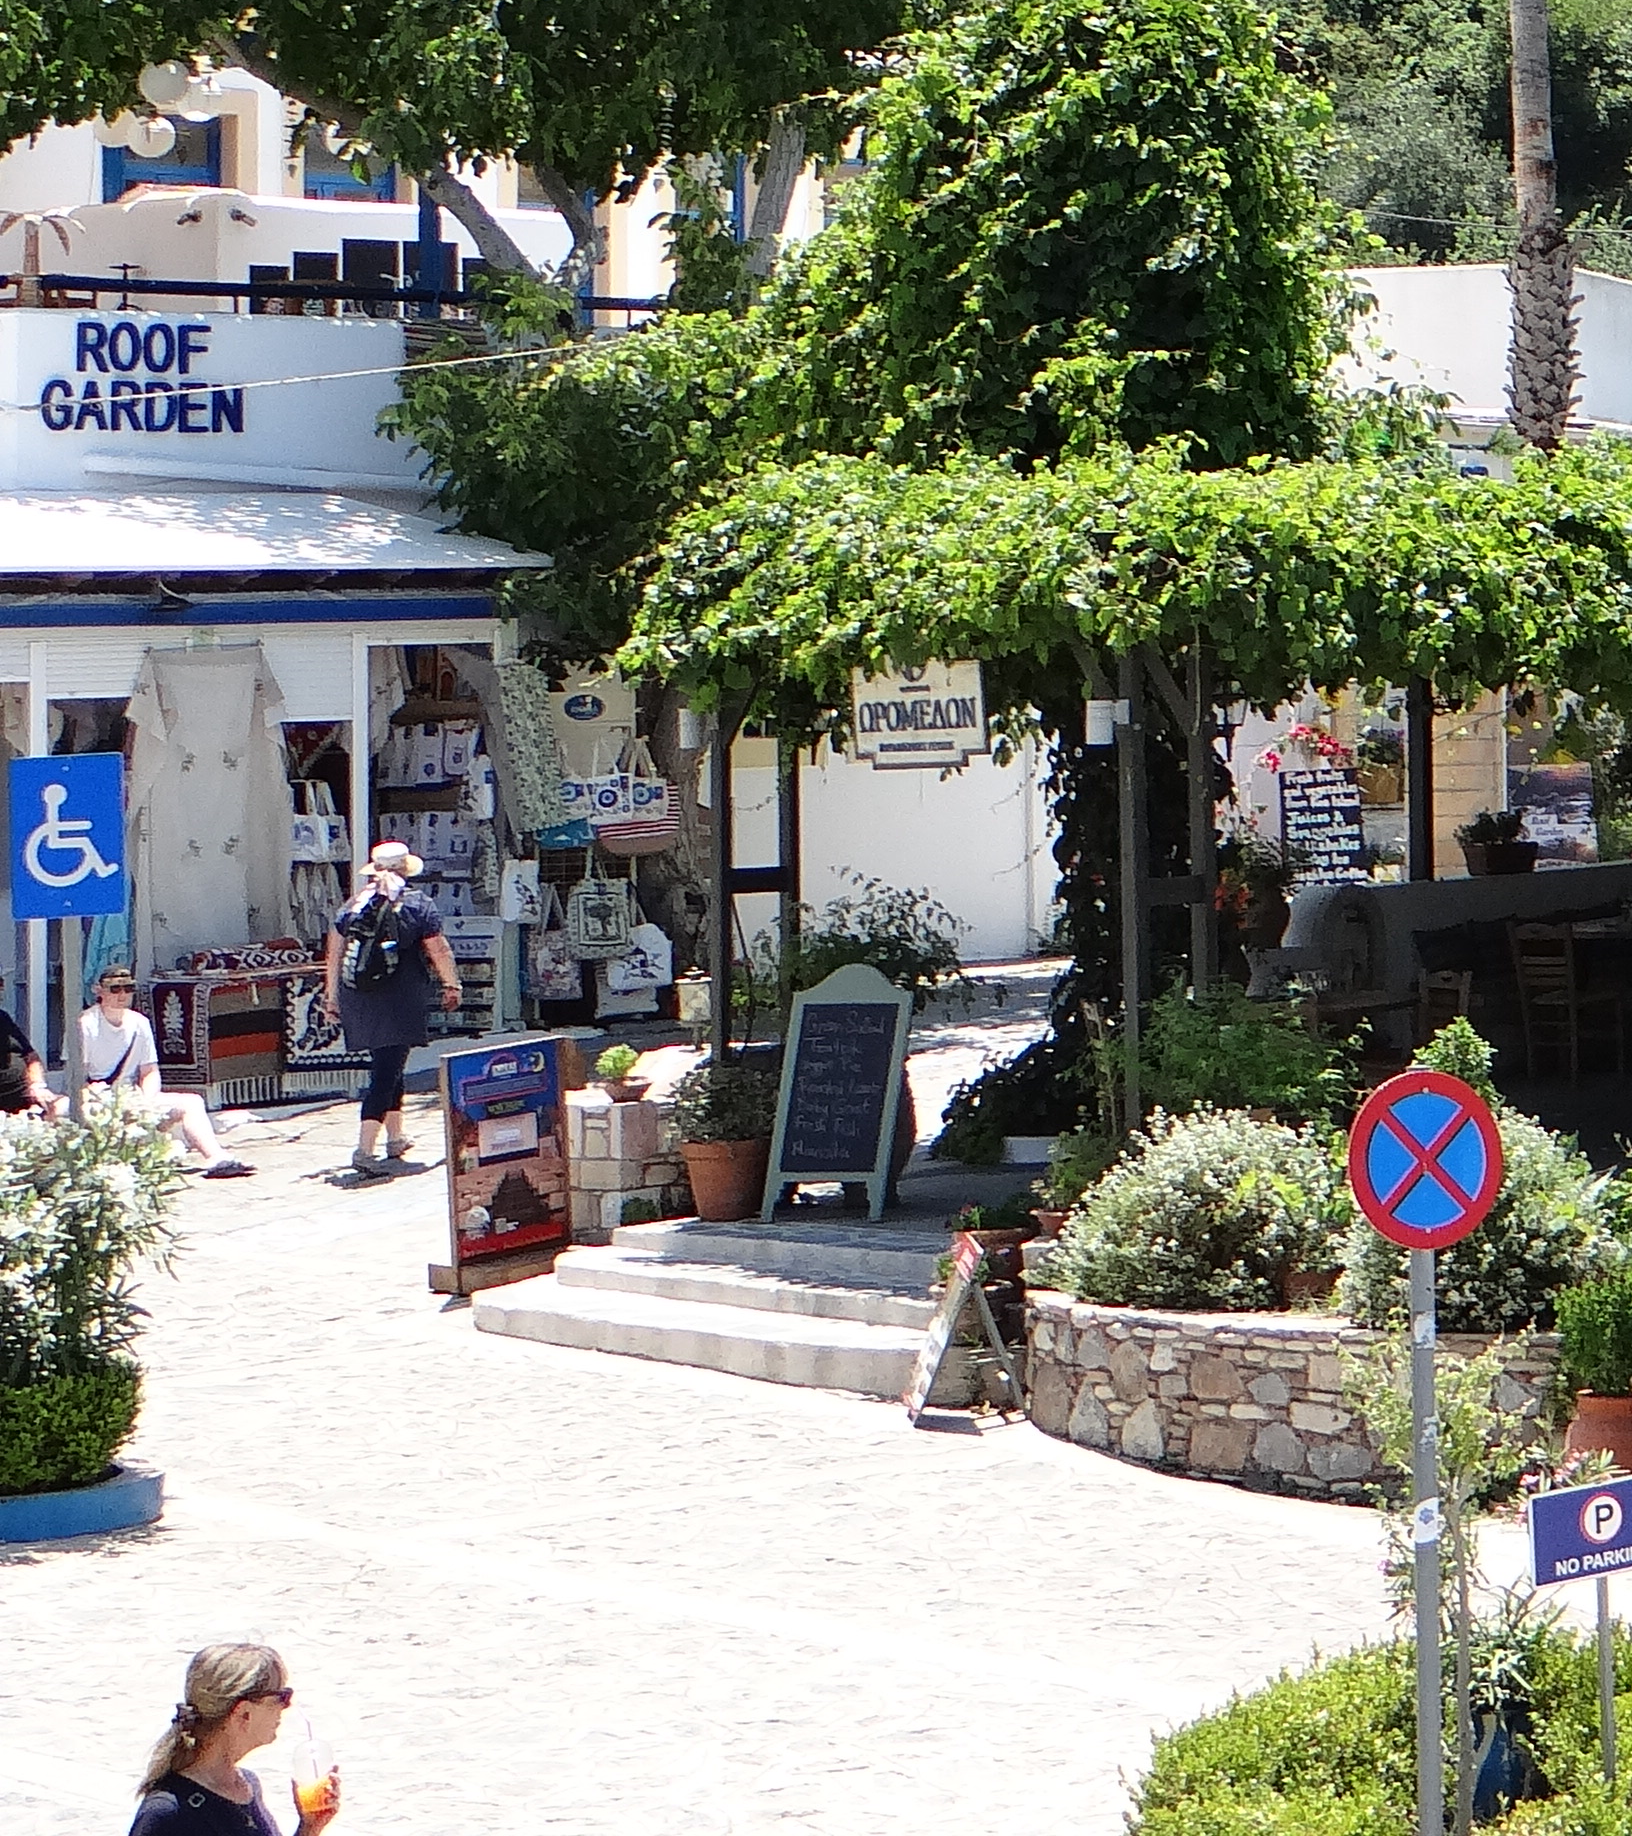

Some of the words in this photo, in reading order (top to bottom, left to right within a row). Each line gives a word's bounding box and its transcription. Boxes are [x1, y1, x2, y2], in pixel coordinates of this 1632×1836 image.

[75, 321, 213, 374] ROOF
[41, 379, 244, 433] GARDEN
[1286, 811, 1330, 825] Juices
[1595, 1503, 1614, 1534] P
[1555, 1557, 1580, 1576] NO
